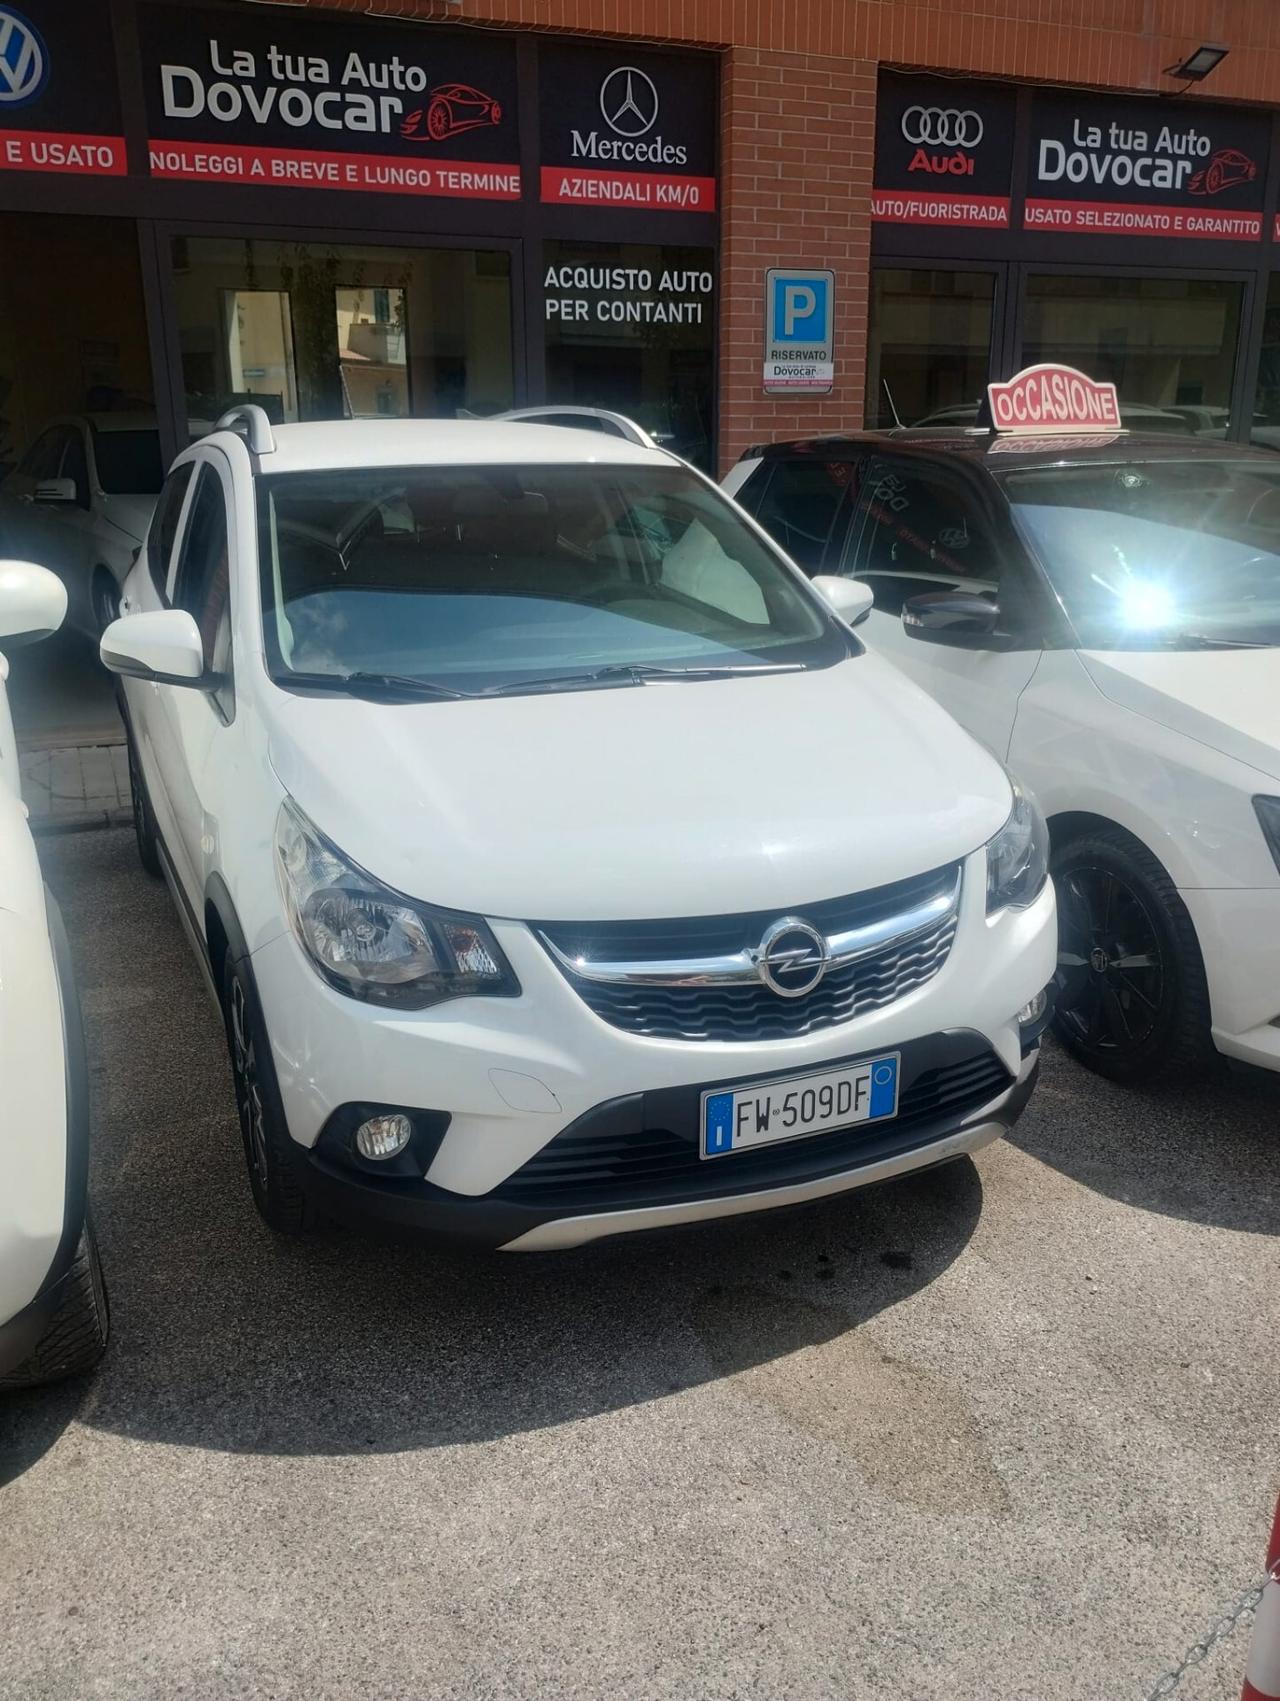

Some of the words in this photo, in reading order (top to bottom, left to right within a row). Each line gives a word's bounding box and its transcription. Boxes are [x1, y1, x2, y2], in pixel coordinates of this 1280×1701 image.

[209, 39, 256, 78] La
[267, 45, 330, 84] tua
[341, 52, 427, 92] Auto
[160, 64, 403, 134] Dovocar
[571, 130, 688, 165] Mercedes
[1073, 119, 1102, 148] La
[1109, 122, 1148, 151] tua
[1154, 126, 1211, 157] Auto
[7, 141, 23, 164] E
[31, 143, 114, 168] USATO
[907, 148, 975, 176] Audi
[1038, 139, 1192, 190] Dovocar
[149, 151, 244, 176] NOLEGGI
[250, 157, 266, 176] A
[272, 159, 339, 182] BREVE
[346, 163, 358, 183] E
[364, 165, 431, 187] LUNGO
[436, 169, 521, 194] TERMINE
[559, 177, 651, 202] AZIENDALI
[1024, 207, 1072, 225] USATO
[1076, 210, 1170, 230] SELEZIONATO
[1173, 214, 1183, 230] E
[1186, 215, 1260, 235] GARANTITO
[544, 266, 652, 293] ACQUISTO
[658, 270, 713, 293] AUTO
[545, 299, 590, 321] PER
[597, 300, 702, 324] CONTANTI
[784, 285, 817, 337] P
[771, 350, 827, 361] RISERVATO
[773, 365, 817, 376] Dovocar
[997, 374, 1115, 421] OCCASIONE
